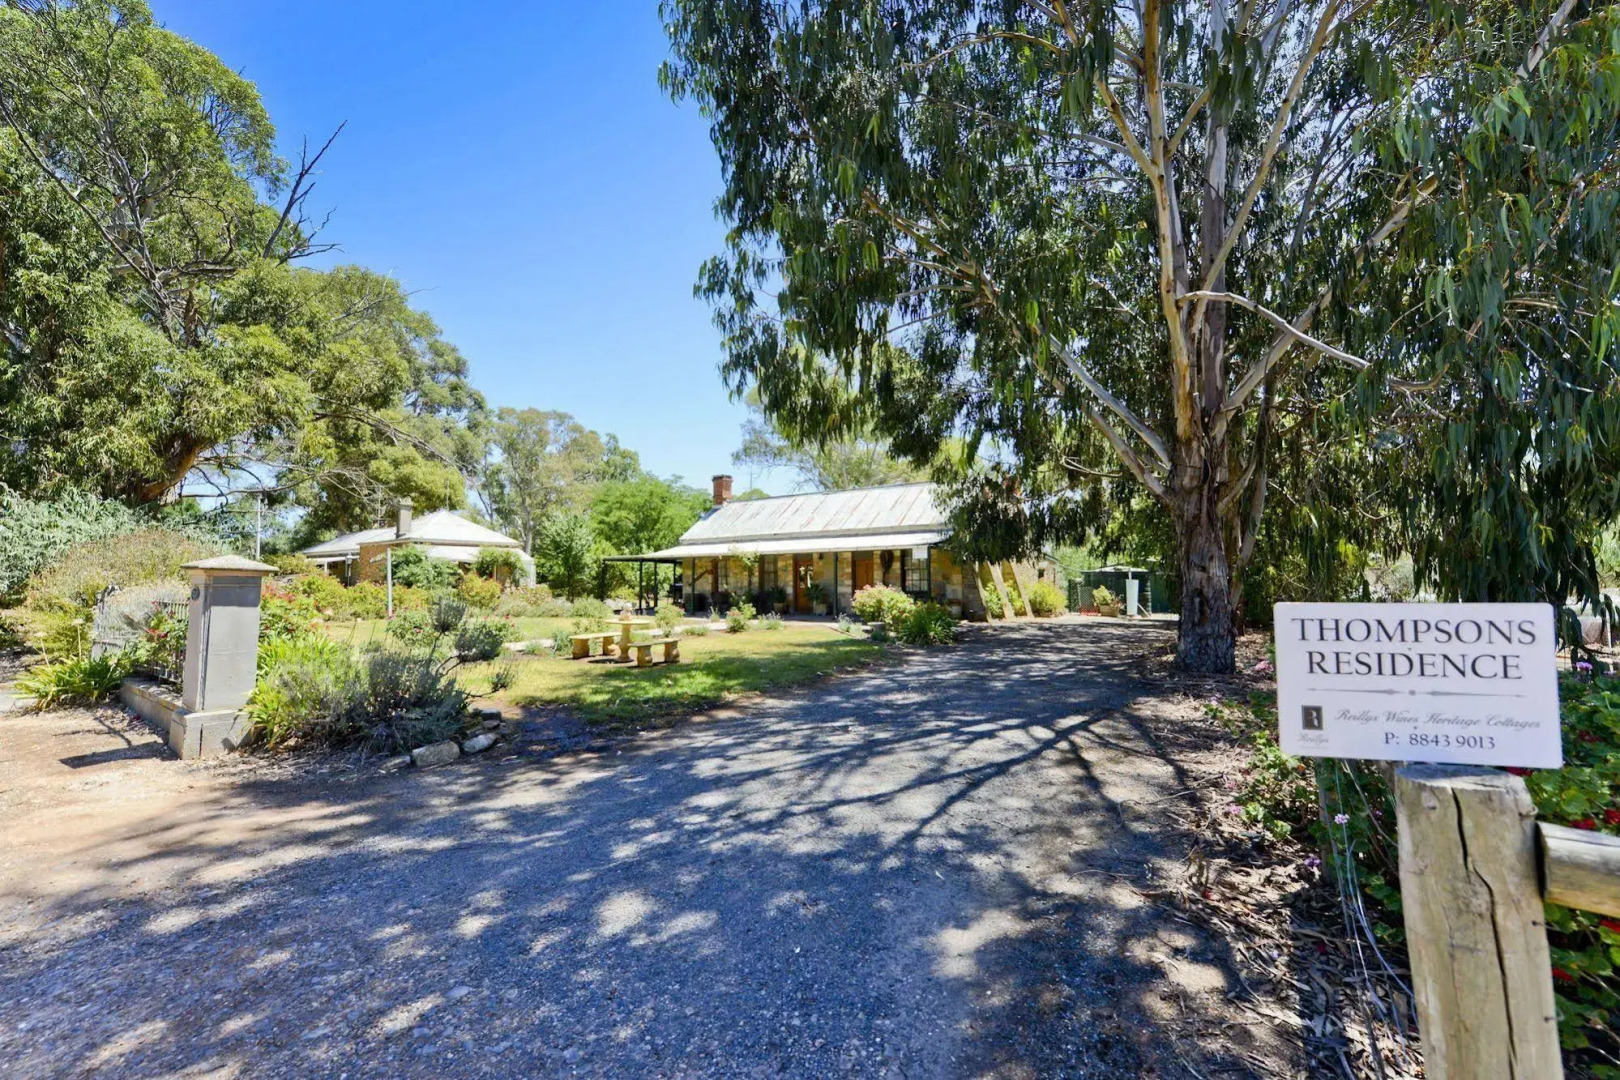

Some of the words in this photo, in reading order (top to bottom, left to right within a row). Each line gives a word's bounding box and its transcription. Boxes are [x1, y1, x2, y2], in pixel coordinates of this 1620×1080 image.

[1291, 618, 1537, 645] THOMPSONS
[1306, 651, 1522, 680] RESIDENCE
[1334, 709, 1378, 725] Reillys
[1383, 711, 1419, 724] Wines
[1423, 713, 1481, 729] Heritage
[1486, 714, 1541, 731] Cottages
[1384, 732, 1400, 745] P:
[1409, 733, 1450, 747] 8843
[1455, 735, 1496, 750] 9013
